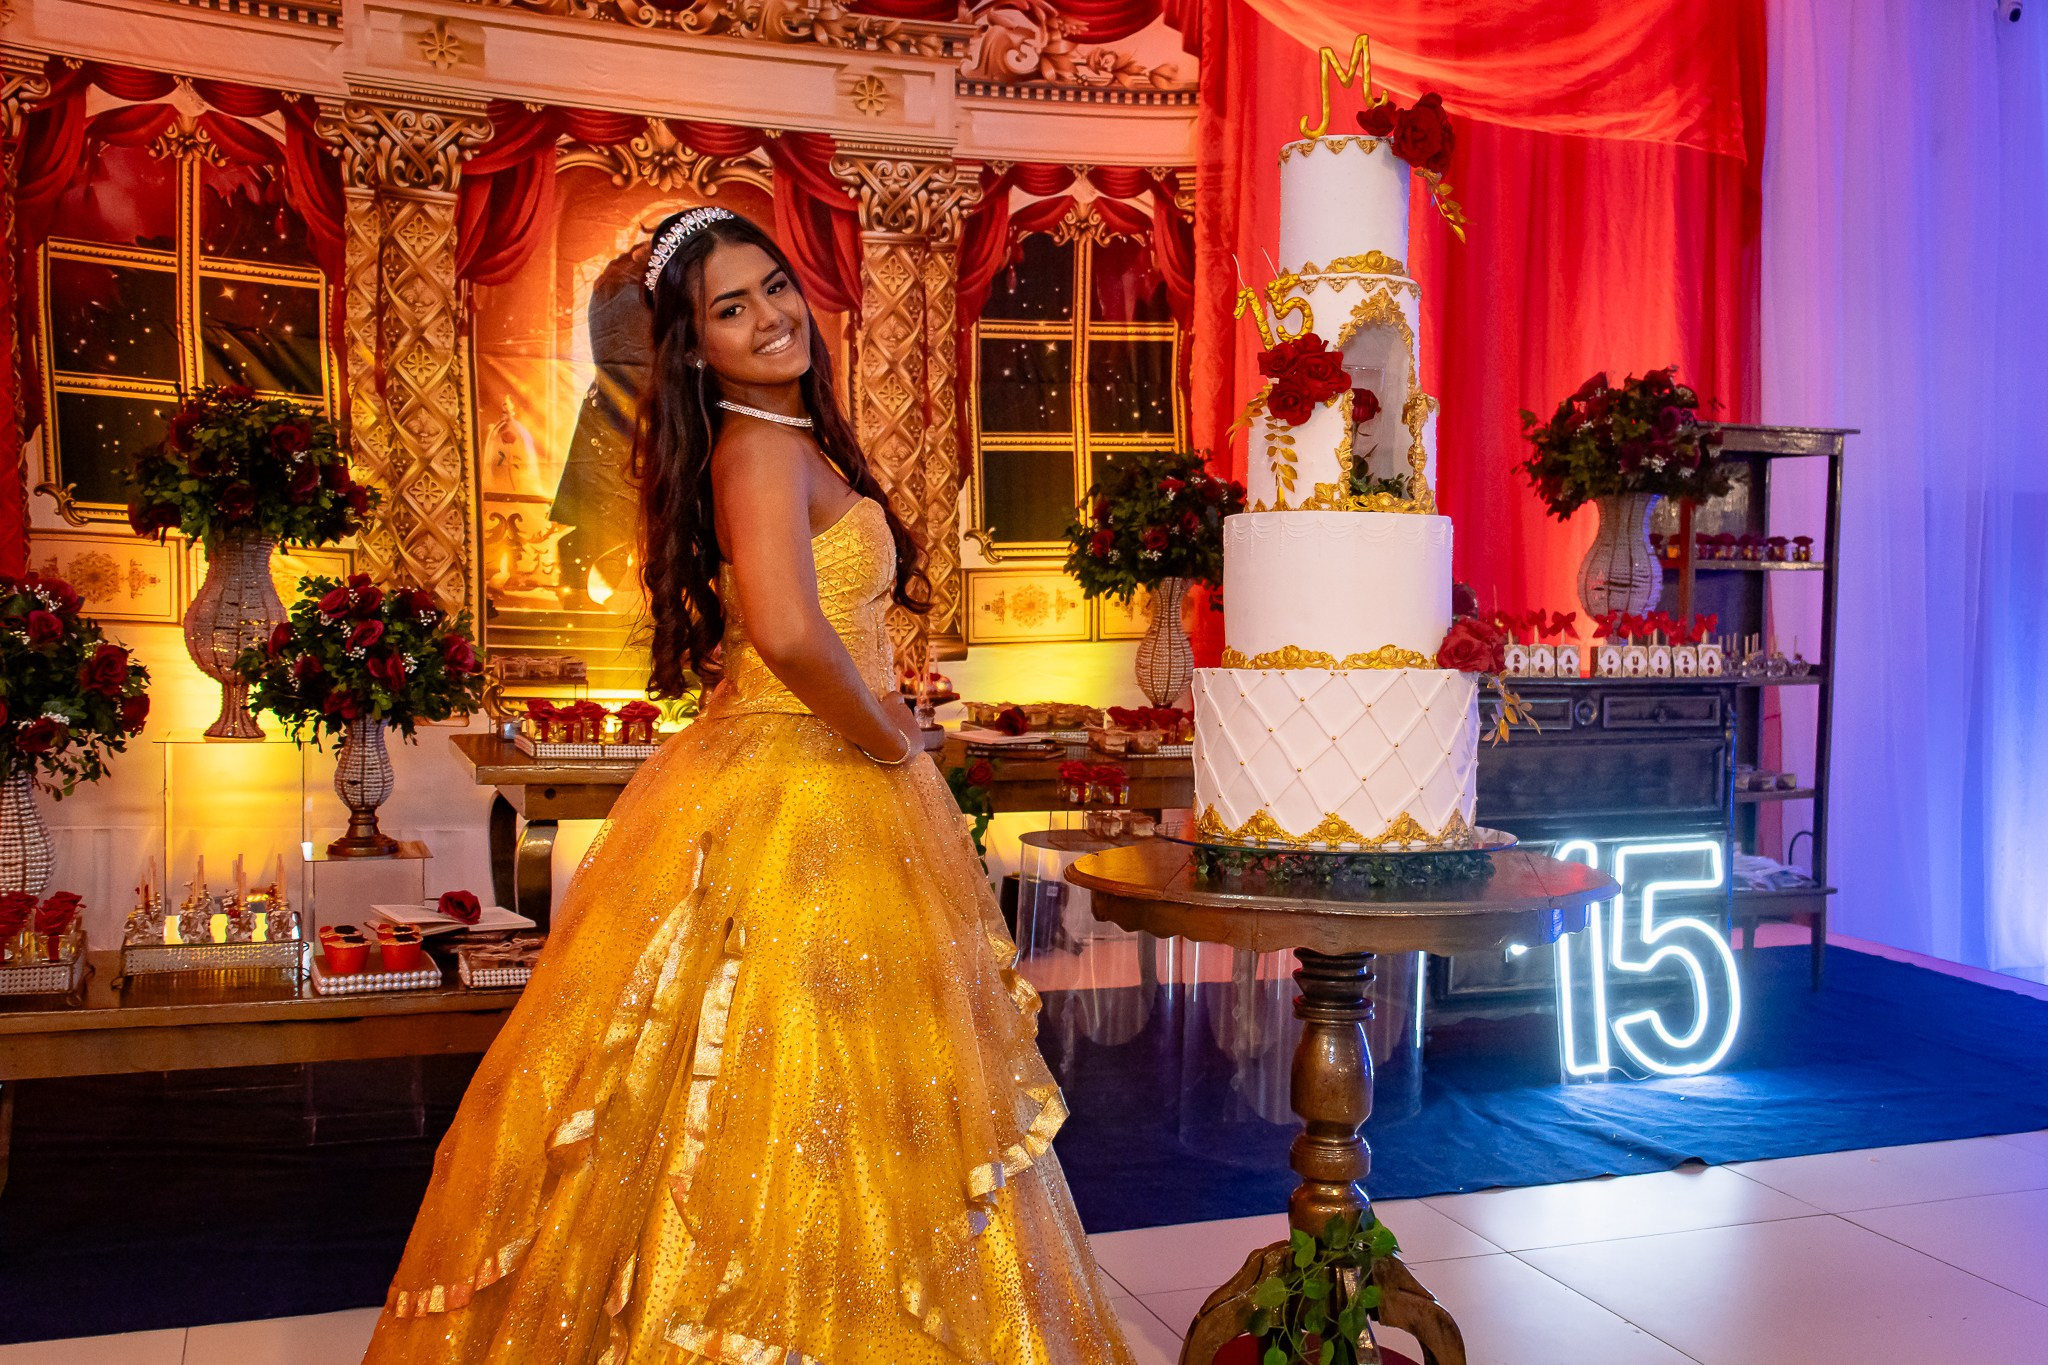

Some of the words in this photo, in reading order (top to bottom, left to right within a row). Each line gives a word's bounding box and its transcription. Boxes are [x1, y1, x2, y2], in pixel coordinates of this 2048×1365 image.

[1298, 33, 1390, 139] M
[1233, 273, 1314, 351] 15
[1606, 654, 1716, 667] LUIZA
[1556, 839, 1742, 1077] 15
